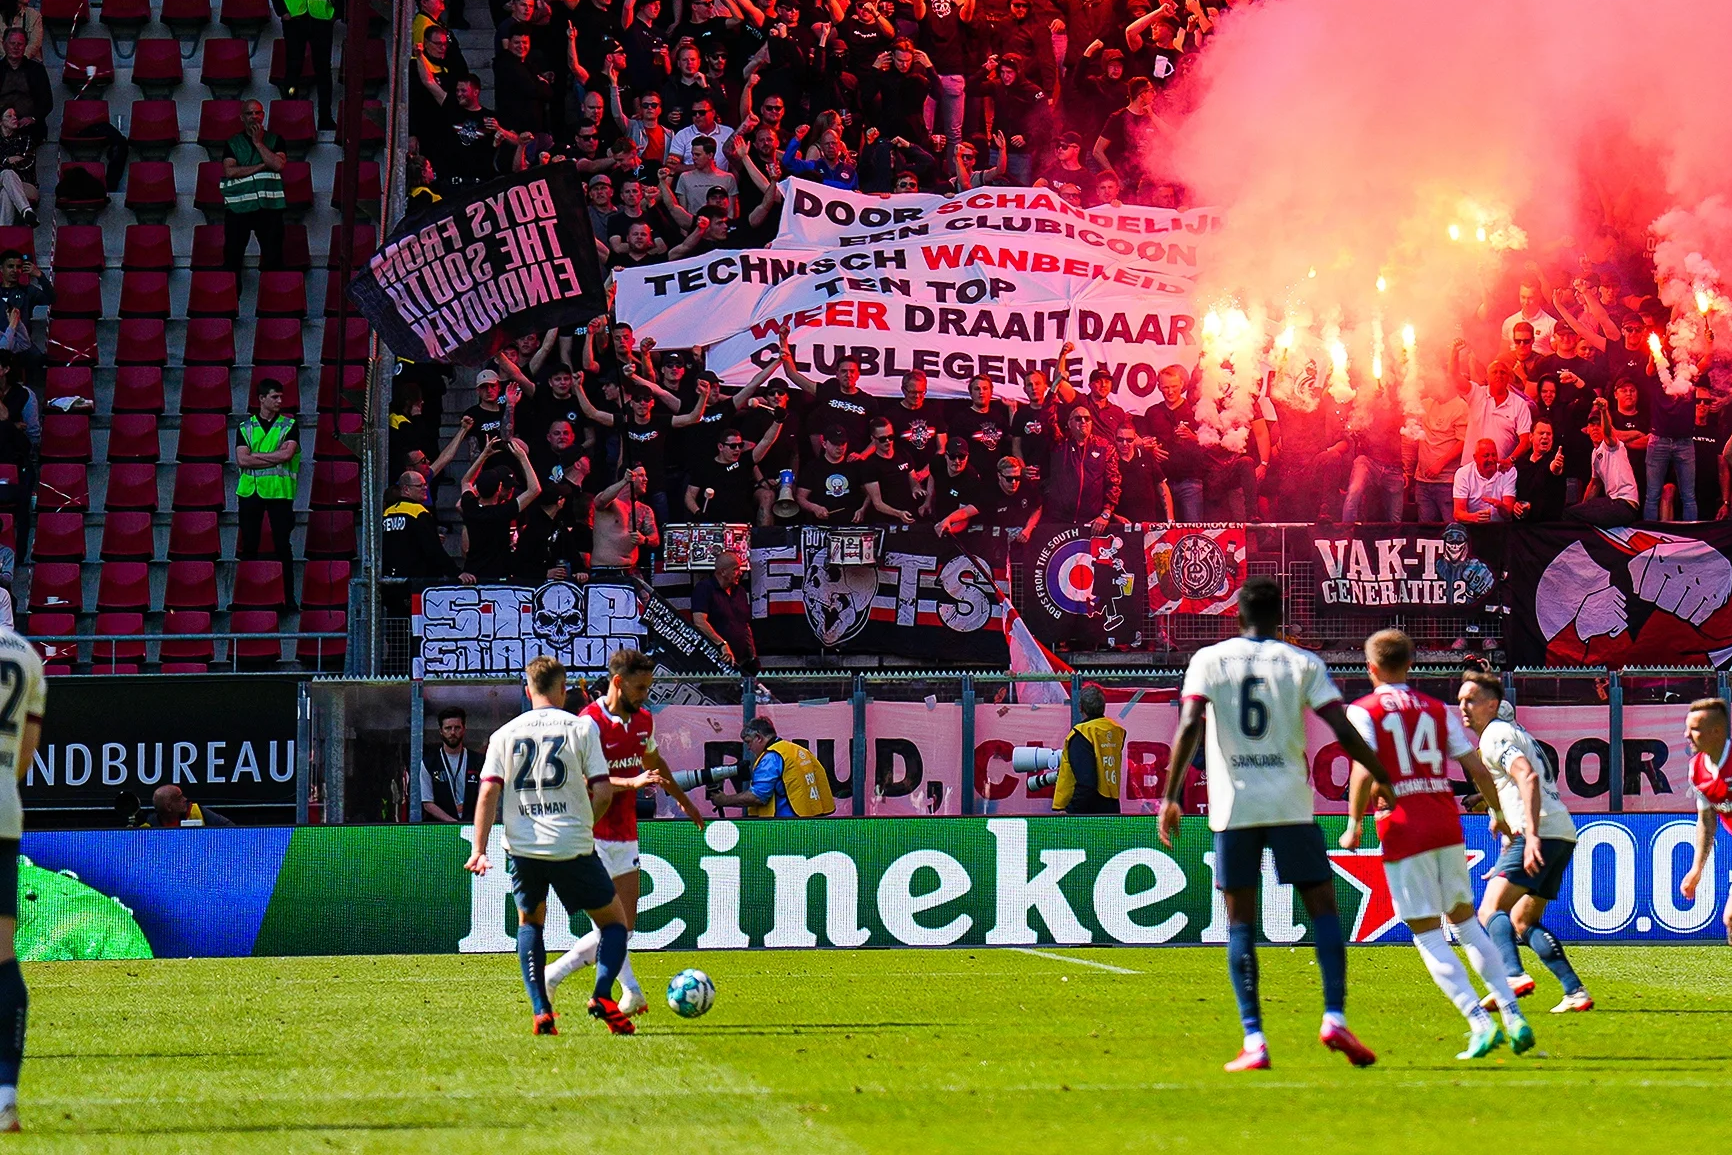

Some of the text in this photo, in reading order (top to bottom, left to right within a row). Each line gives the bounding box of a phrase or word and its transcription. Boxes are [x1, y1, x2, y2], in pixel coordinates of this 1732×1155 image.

[793, 188, 924, 227] DOOR
[839, 215, 1198, 267] EEN CLUBICOON
[644, 244, 1185, 296] TECHNISCH WANBELEID
[815, 276, 1017, 304] TEN TOP
[751, 301, 1197, 346] WEER DRAAIT DAAR
[1034, 528, 1079, 620] BOYS FROM THE SOUTH
[1314, 538, 1445, 581] VAK-T
[1322, 580, 1467, 605] GENERATIE 2
[1240, 675, 1271, 740] 6
[513, 735, 568, 792] 23
[1381, 711, 1443, 776] 14
[704, 738, 943, 813] RUD,
[519, 802, 568, 817] VEERMAN
[459, 819, 1307, 952] Heineken
[1571, 820, 1716, 934] 0.0
